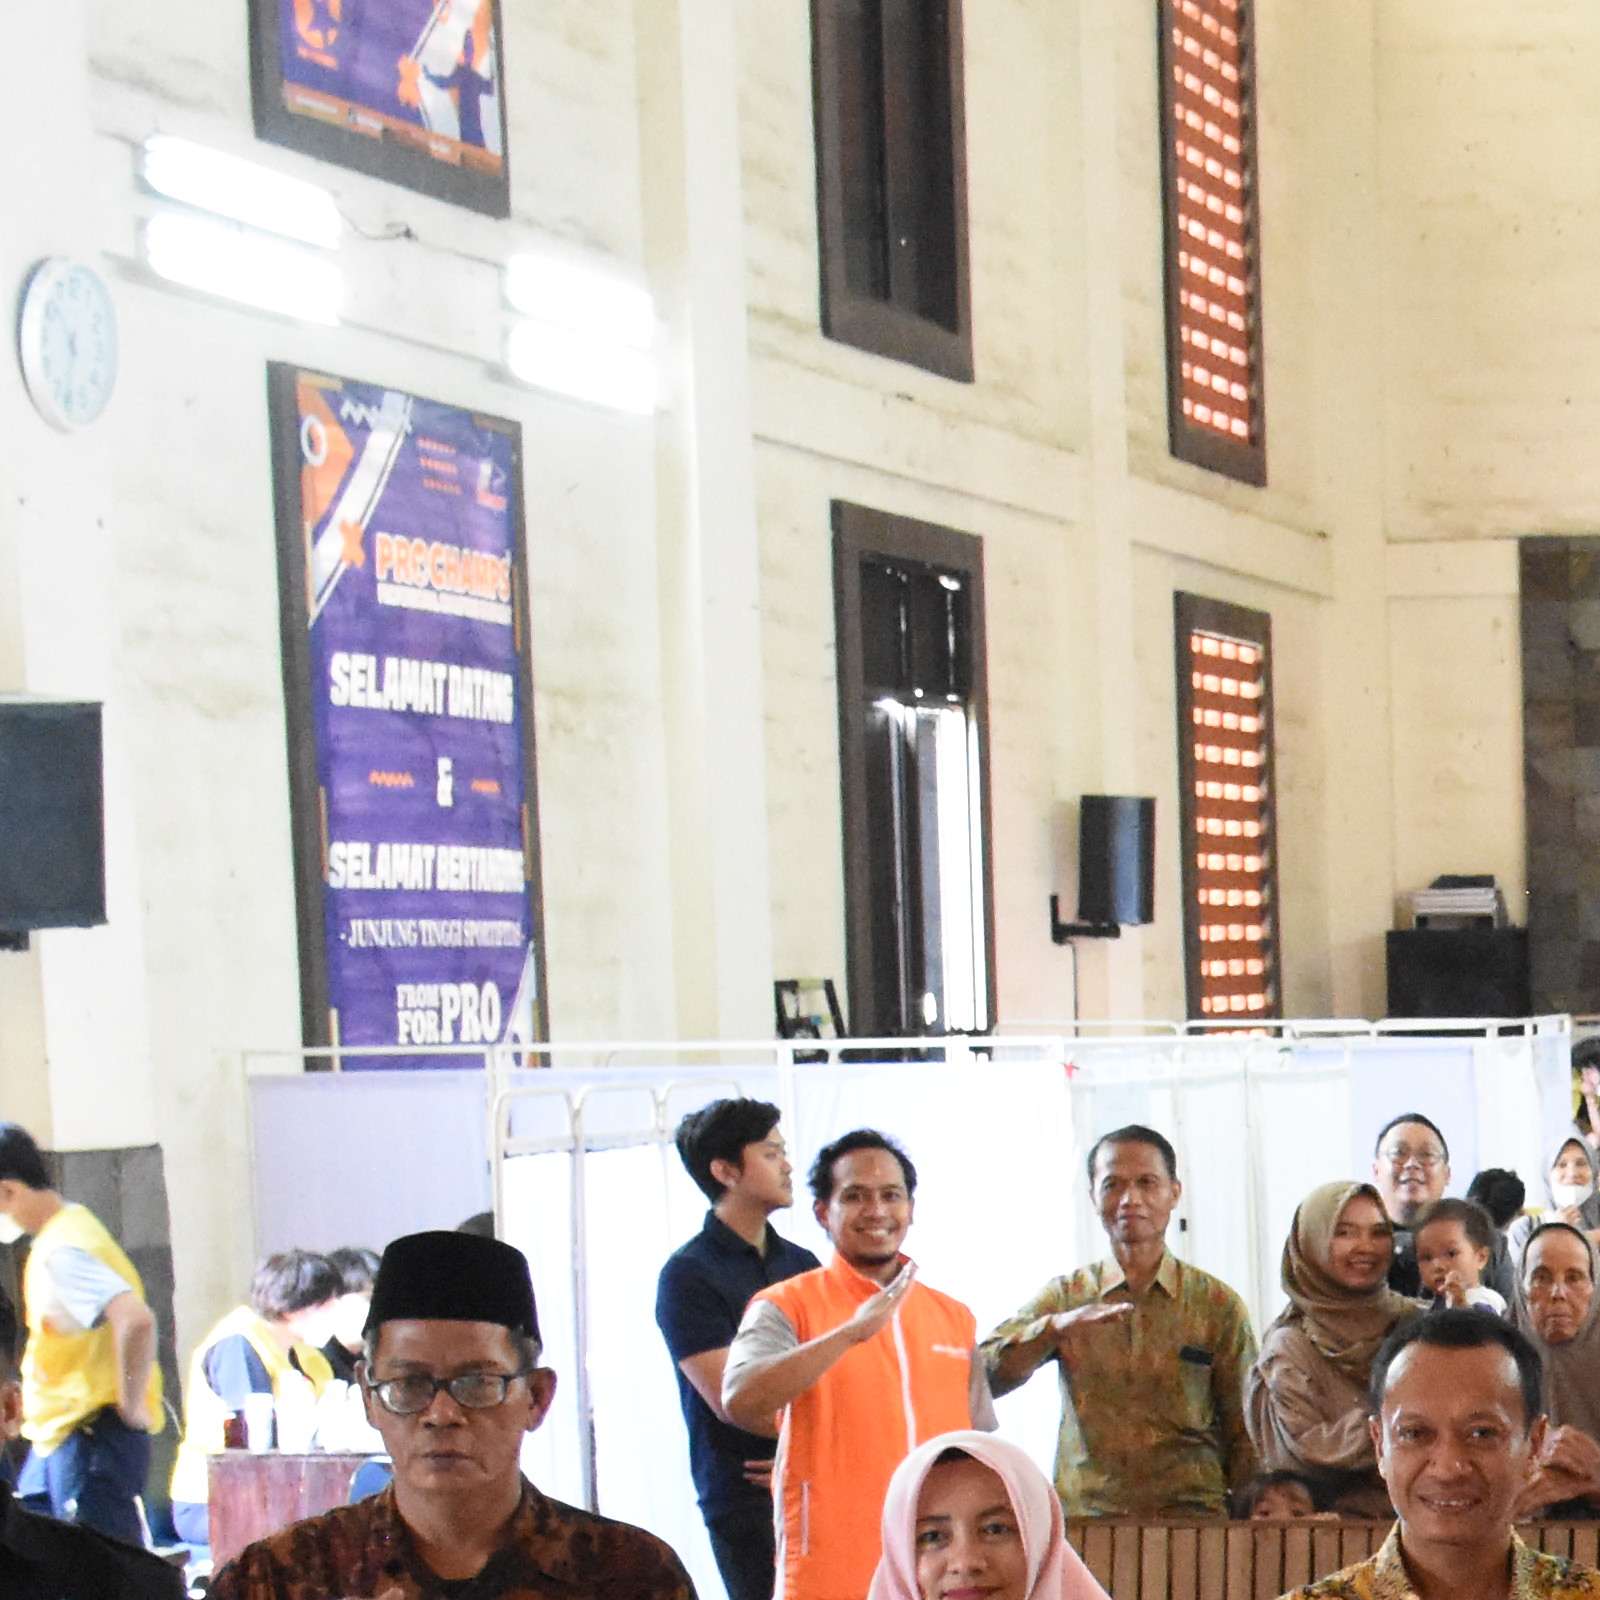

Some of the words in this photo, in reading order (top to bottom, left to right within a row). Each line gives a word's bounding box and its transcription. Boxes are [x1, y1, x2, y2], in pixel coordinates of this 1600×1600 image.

[329, 653, 446, 715] SELAMAT
[448, 666, 515, 725] DATANG
[328, 840, 435, 891] SELAMAT
[349, 917, 417, 948] JUNJUNG
[397, 1010, 439, 1044] FOR
[441, 982, 501, 1043] PRO
